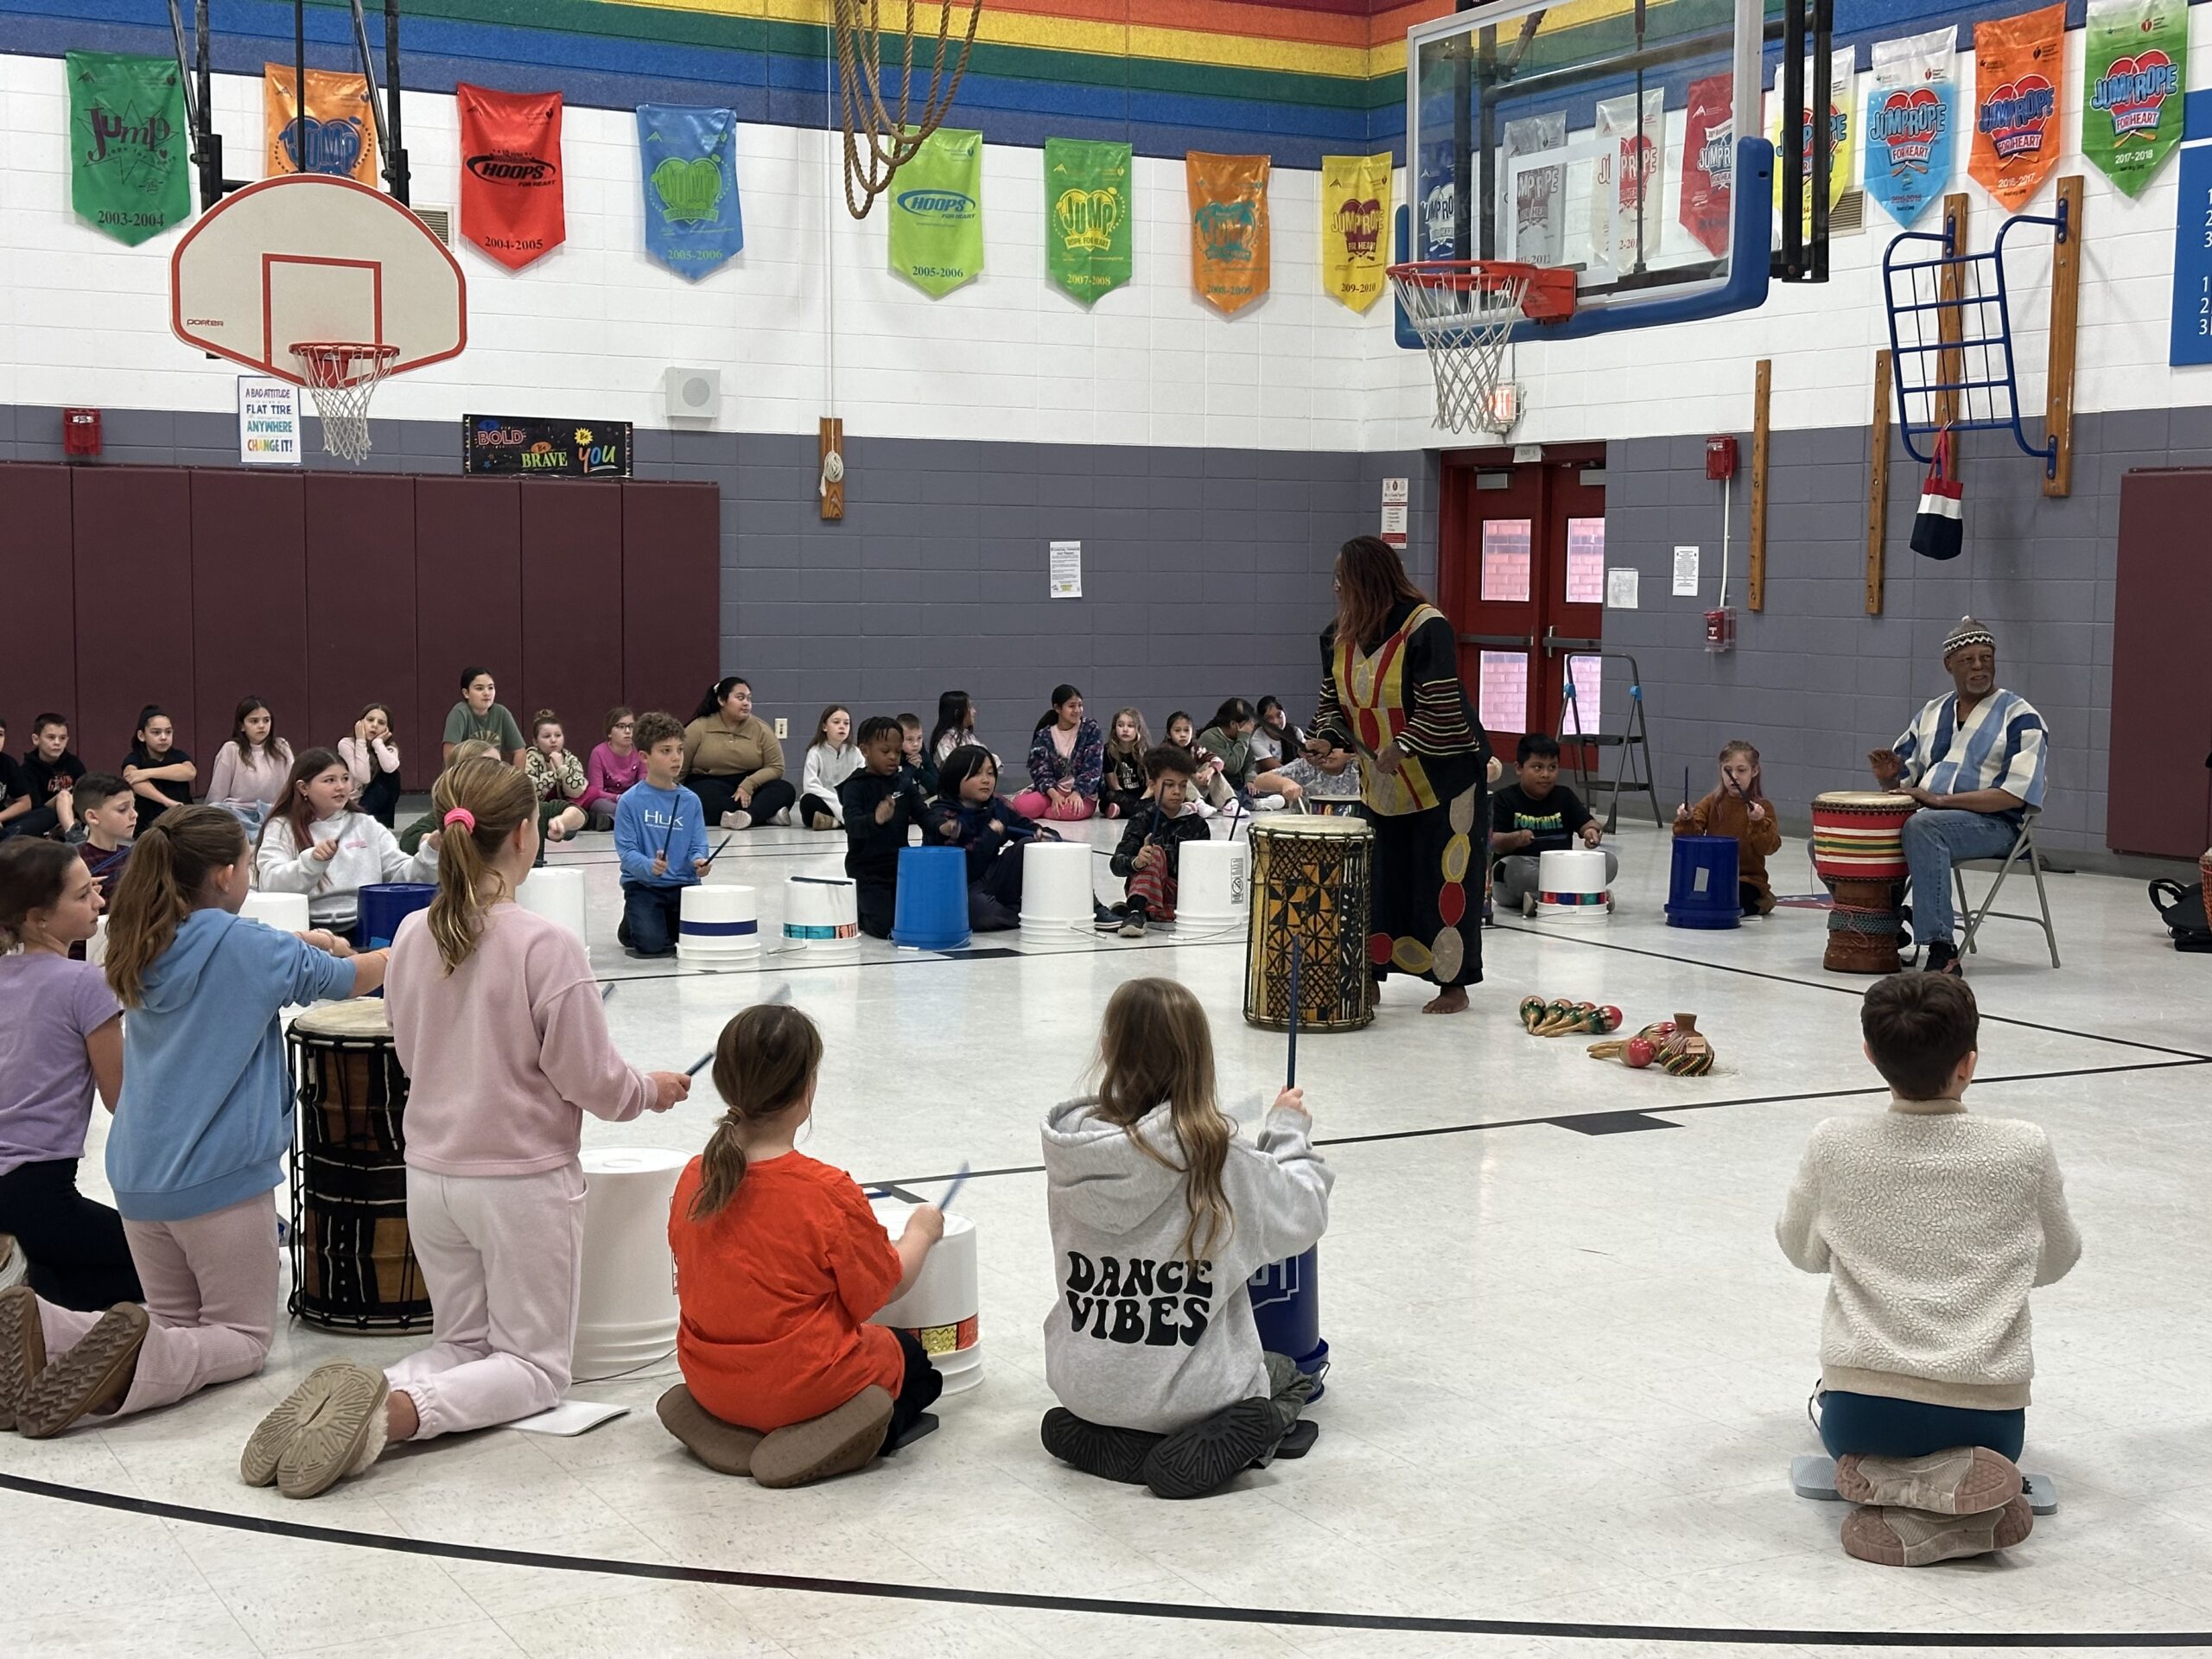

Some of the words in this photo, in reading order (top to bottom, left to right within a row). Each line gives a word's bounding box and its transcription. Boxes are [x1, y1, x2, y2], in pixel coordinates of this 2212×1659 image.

[2090, 72, 2133, 110] JUMP
[2133, 63, 2179, 105] ROPE
[2013, 87, 2056, 130] ROPE
[1870, 107, 1909, 141] JUMP
[1909, 102, 1947, 137] ROPE
[2116, 117, 2130, 131] FOR
[2130, 112, 2158, 127] HEART
[2012, 135, 2041, 150] HEART
[1698, 146, 1724, 170] JUMP
[2115, 149, 2153, 164] 2017-2018
[481, 162, 546, 180] HOOPS
[911, 196, 967, 212] HOOPS
[98, 211, 164, 227] 2003-2004
[1063, 194, 1113, 236] JUMP
[1332, 211, 1361, 235] JUMP
[484, 236, 543, 251] 2004-2005
[2203, 232, 2212, 248] 3
[912, 266, 963, 278] 2005-2006
[1066, 273, 1111, 286] 2007-2008
[2202, 276, 2209, 293] 1
[2200, 297, 2209, 315] 2
[2198, 318, 2208, 335] 3
[245, 388, 250, 398] A
[251, 388, 264, 398] BAD
[264, 389, 290, 398] ATTITUDE
[246, 404, 267, 414] FLAT
[270, 404, 292, 415] TIRE
[247, 420, 293, 432] ANYWHERE
[247, 439, 279, 452] CHANGE
[281, 439, 293, 452] IT!
[477, 429, 524, 445] BOLD
[521, 451, 569, 468] BRAVE
[1514, 812, 1564, 830] FORTNITE
[1066, 1251, 1213, 1299] DANCE
[1065, 1290, 1210, 1347] VIBES
